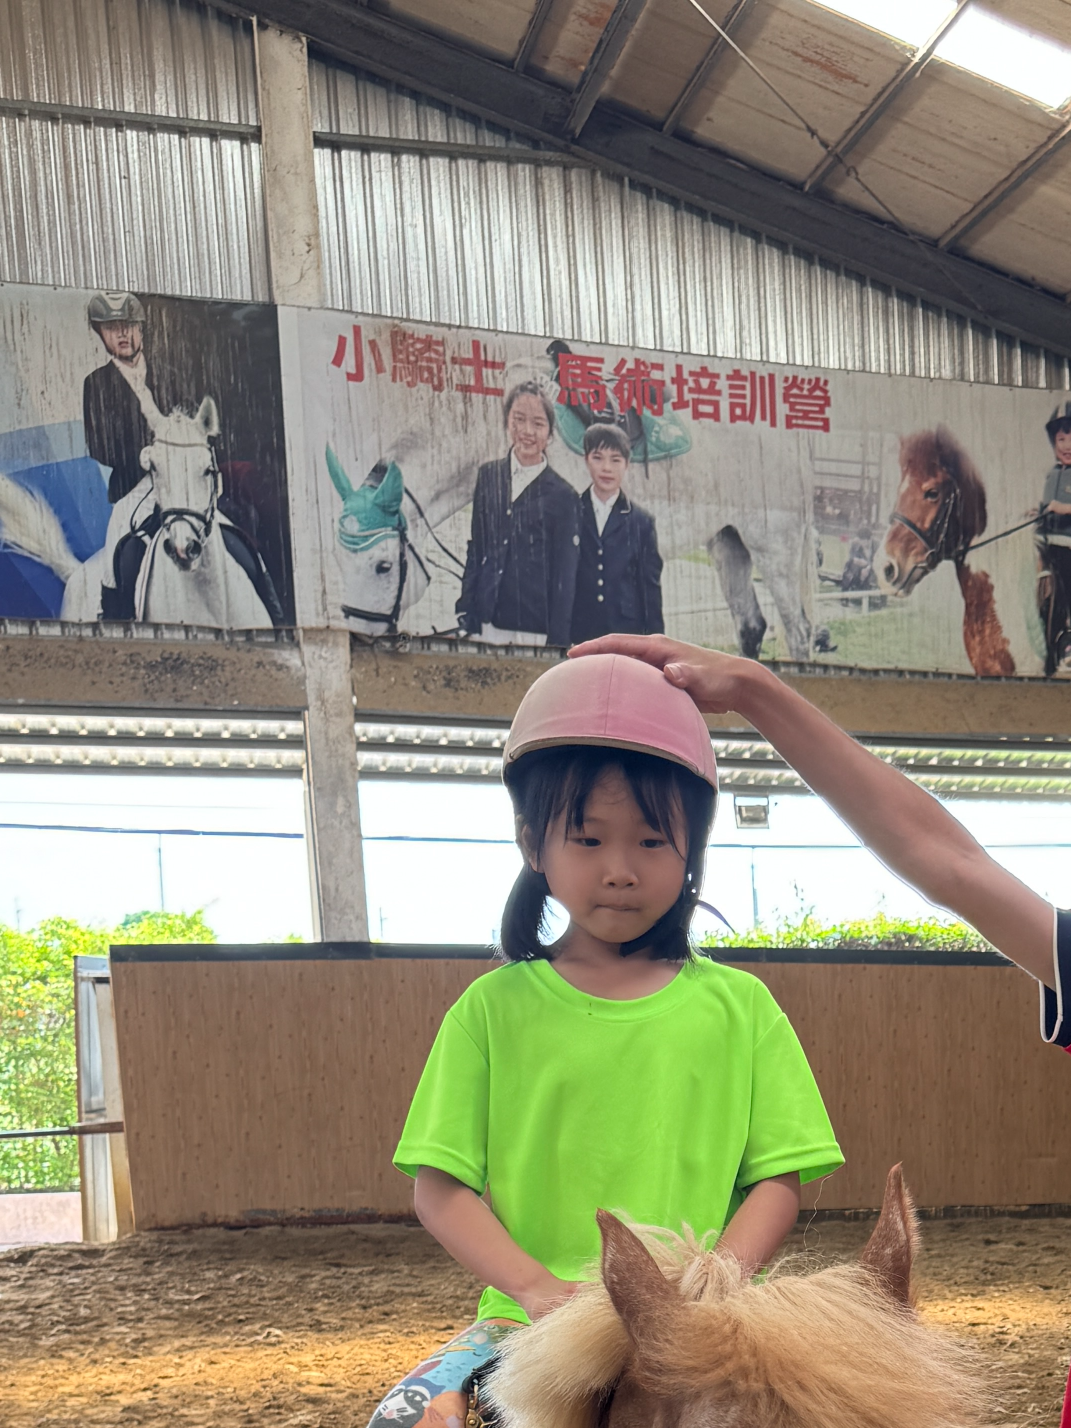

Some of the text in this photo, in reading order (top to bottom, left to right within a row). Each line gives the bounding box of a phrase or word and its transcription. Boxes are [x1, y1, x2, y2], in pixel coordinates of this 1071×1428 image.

[331, 324, 831, 433] 小騎士 馬術培訓營
